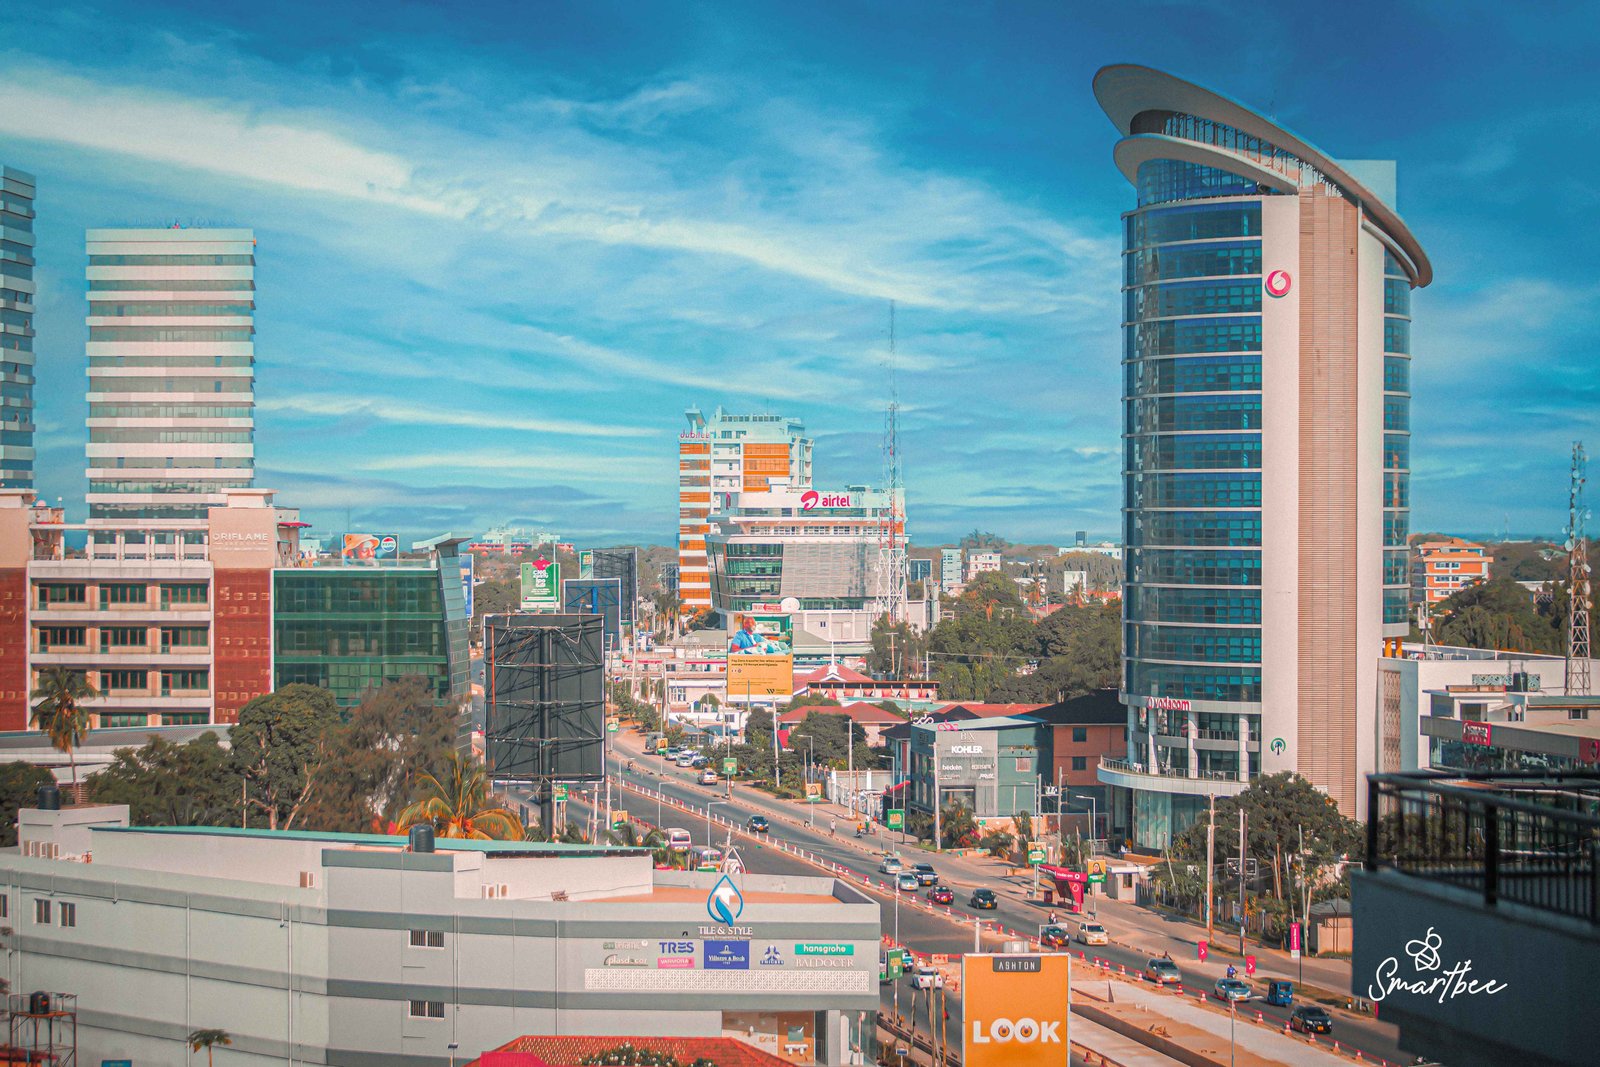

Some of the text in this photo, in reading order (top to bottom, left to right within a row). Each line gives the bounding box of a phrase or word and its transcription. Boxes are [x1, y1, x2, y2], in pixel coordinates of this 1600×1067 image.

[822, 495, 850, 507] airtel
[213, 533, 269, 541] ORIFLAME
[1155, 696, 1191, 711] vodacom
[698, 926, 753, 935] TILE & STYLE
[659, 942, 694, 954] TRES
[803, 944, 846, 954] hansgrohe
[796, 959, 854, 967] BALDOCER
[998, 961, 1036, 971] ASHTON
[972, 1018, 1061, 1044] LOOK
